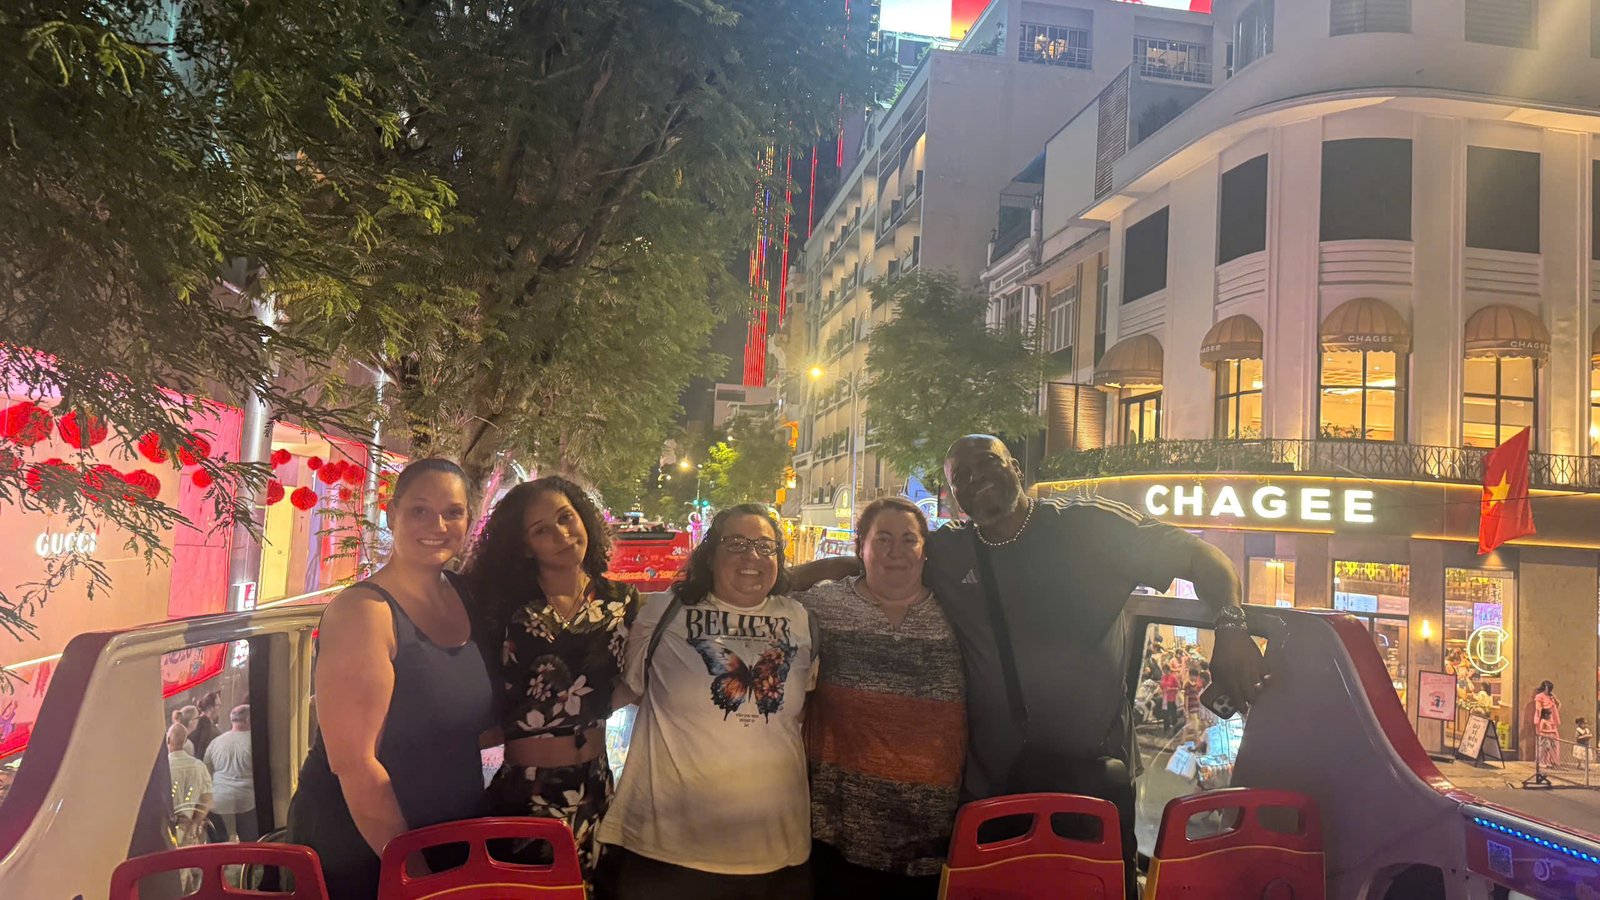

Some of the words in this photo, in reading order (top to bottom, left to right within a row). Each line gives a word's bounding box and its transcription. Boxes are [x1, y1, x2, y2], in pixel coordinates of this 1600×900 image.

[1348, 335, 1393, 343] CHAGEE
[1200, 344, 1221, 353] AGEE
[1510, 340, 1549, 351] CHAGEE
[1145, 484, 1374, 523] CHAGEE
[36, 533, 96, 556] GUCCI
